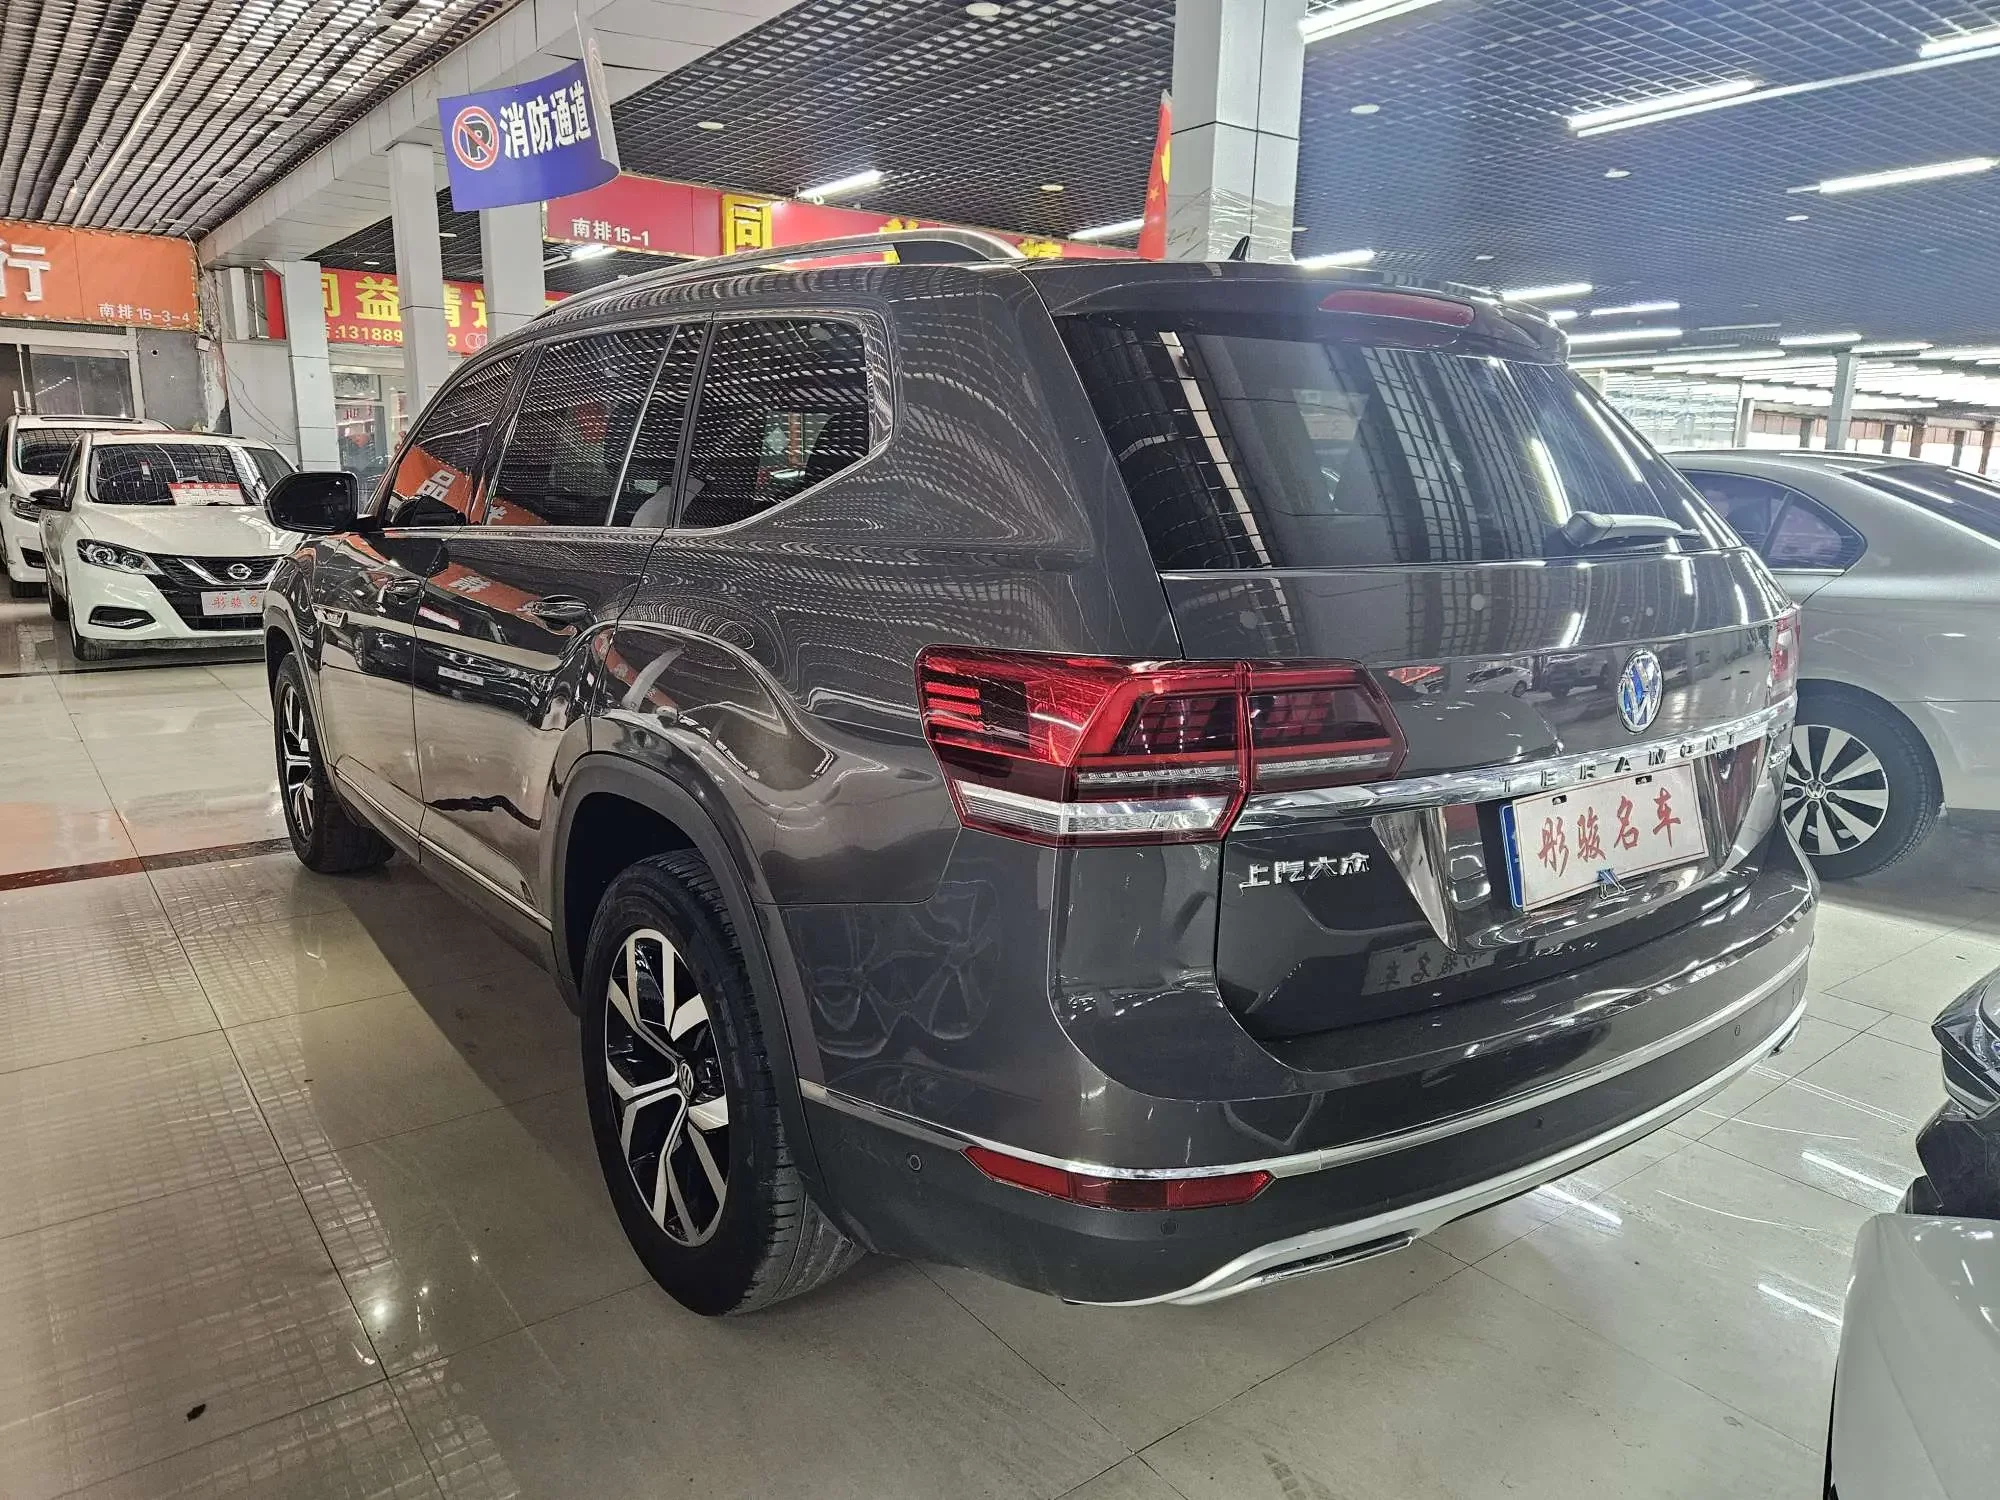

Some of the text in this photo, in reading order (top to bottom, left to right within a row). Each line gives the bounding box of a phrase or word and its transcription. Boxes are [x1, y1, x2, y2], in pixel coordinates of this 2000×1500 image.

[500, 79, 592, 159] 消防通道
[572, 216, 649, 246] 南排15-1
[98, 301, 190, 324] 南排15-3-4
[1537, 786, 1681, 878] 彤骏名车
